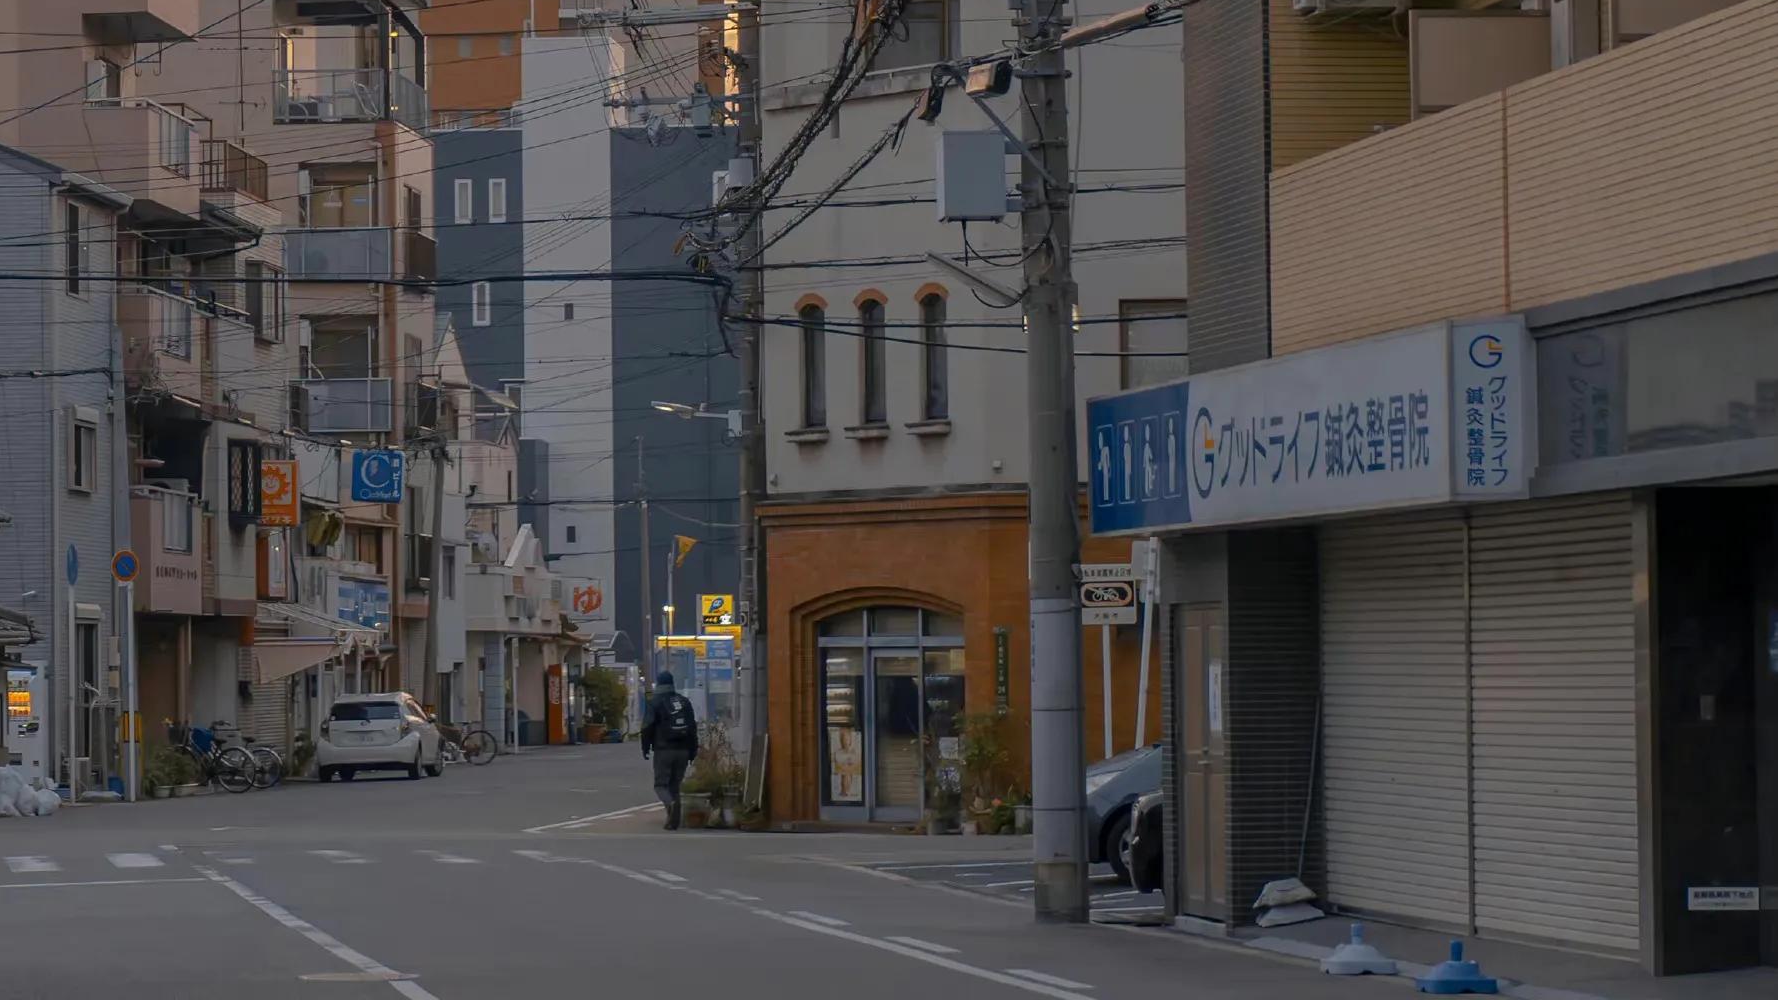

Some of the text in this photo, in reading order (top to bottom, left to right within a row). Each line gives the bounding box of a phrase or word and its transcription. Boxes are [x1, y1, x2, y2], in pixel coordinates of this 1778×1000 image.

[1218, 388, 1430, 488] グッドライフ鍼灸整骨院
[1466, 386, 1486, 487] 鍼灸整骨院
[1488, 375, 1510, 487] グッドライフ
